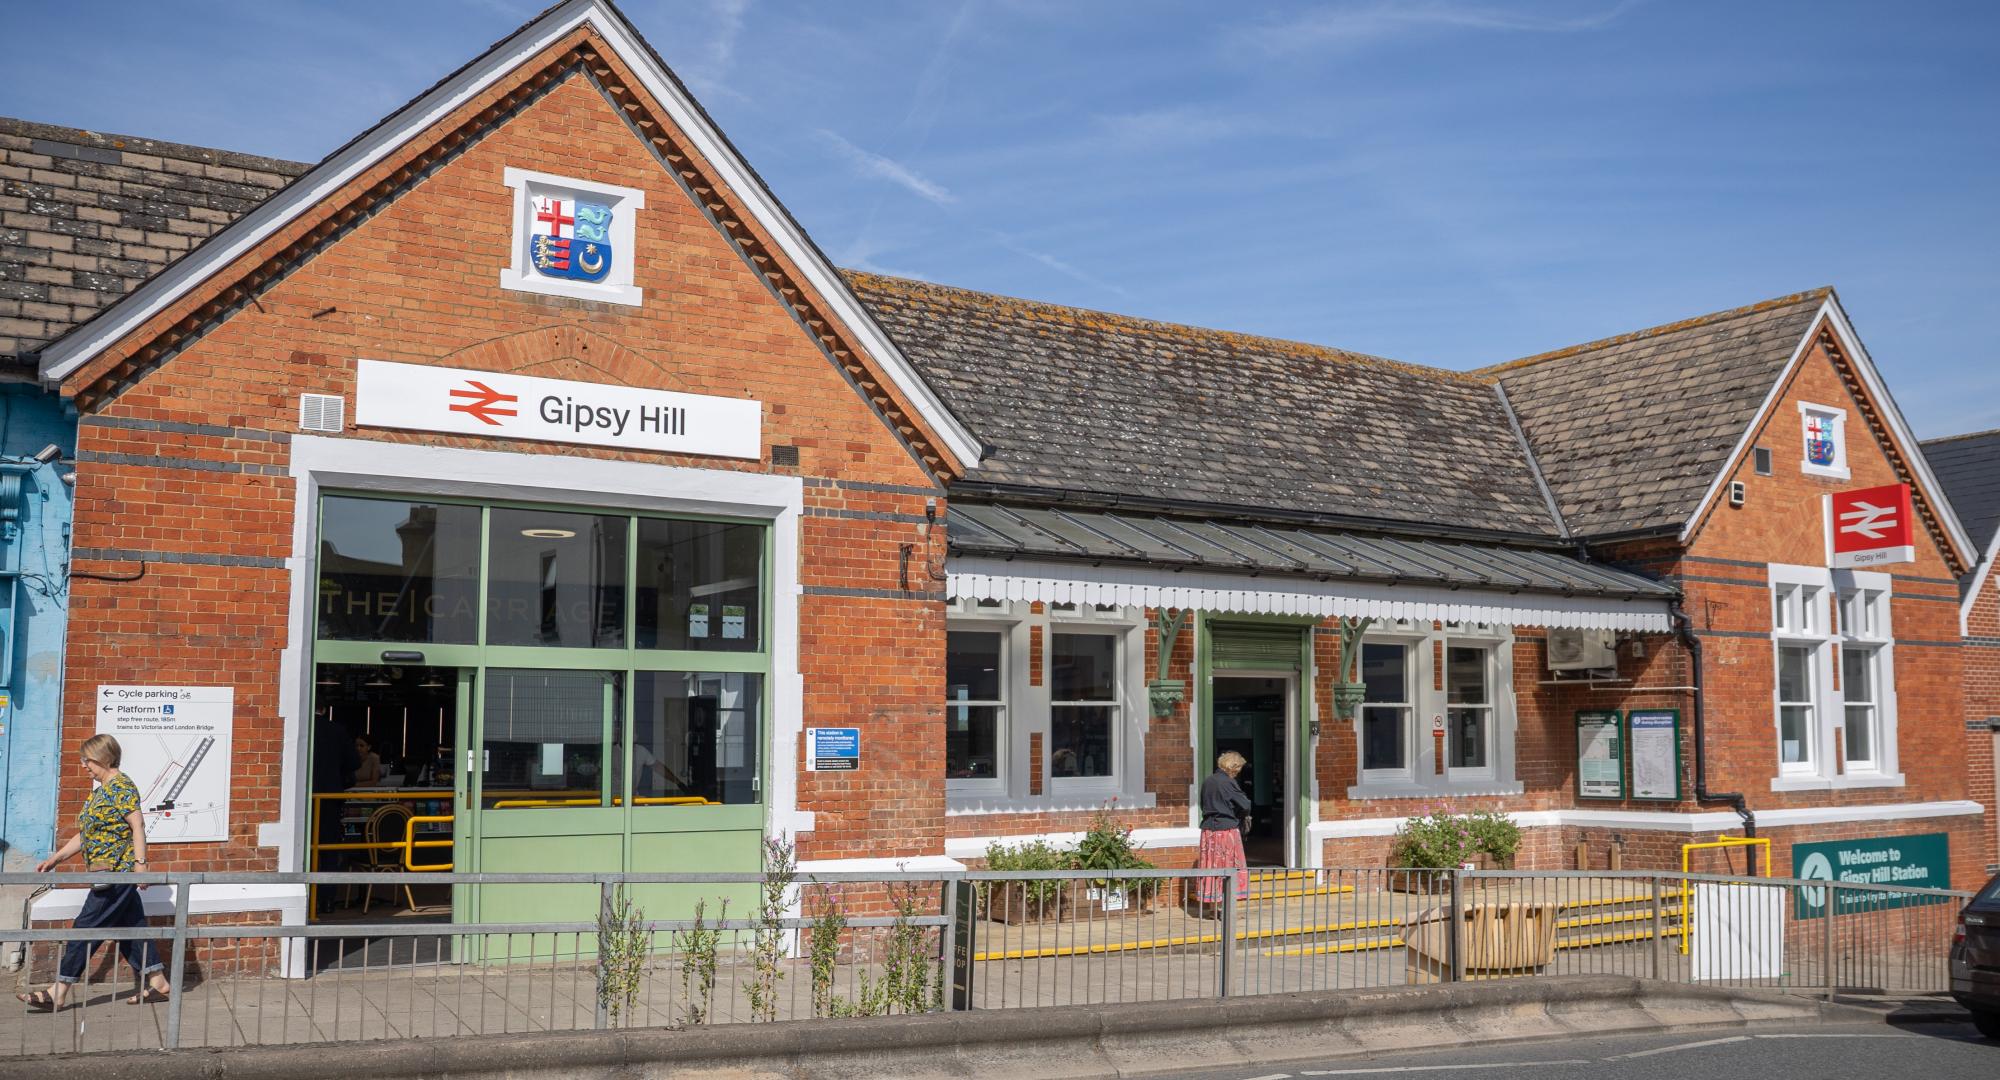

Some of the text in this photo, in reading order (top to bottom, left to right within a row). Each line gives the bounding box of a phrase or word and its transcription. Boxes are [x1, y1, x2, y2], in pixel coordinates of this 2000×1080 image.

[540, 395, 686, 437] Gipsy Hill
[1854, 552, 1887, 562] Gipsy Hill
[320, 590, 617, 624] THE CARRIAGE
[118, 689, 178, 699] Cycle parking
[117, 705, 161, 713] Platform 1
[1838, 848, 1901, 866] Welcome to
[1840, 864, 1928, 884] Gipsy Hill Station
